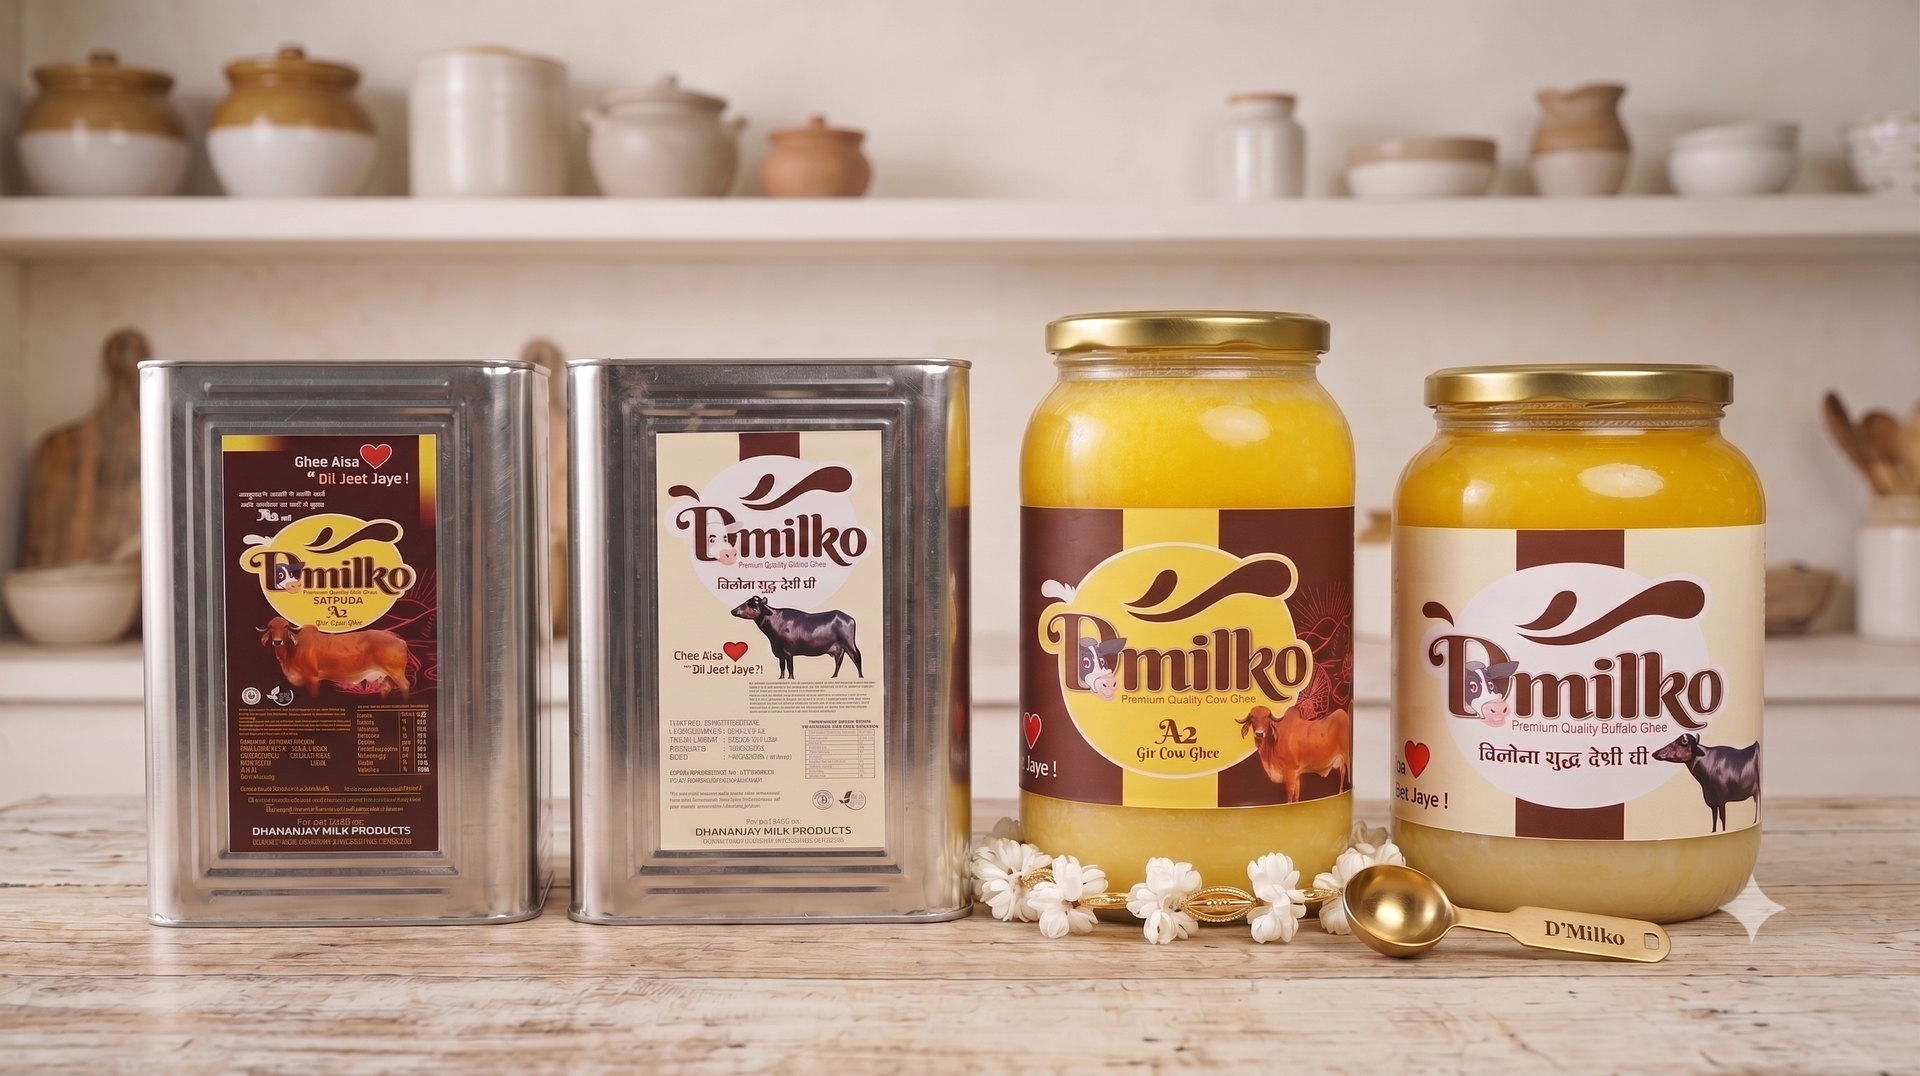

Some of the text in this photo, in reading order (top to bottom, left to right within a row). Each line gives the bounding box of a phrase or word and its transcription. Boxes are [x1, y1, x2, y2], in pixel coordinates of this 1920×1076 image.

[295, 456, 360, 467] Ghee Aisa
[319, 473, 336, 485] Dil
[339, 473, 368, 485] Jeet
[371, 473, 402, 487] Jaye
[738, 561, 764, 569] Premium
[803, 577, 817, 590] घी
[313, 596, 364, 605] SATPUDA
[674, 651, 700, 661] Chee
[706, 664, 730, 675] Jeet
[1121, 693, 1257, 707] Premium Quality Cow Ghee
[1154, 718, 1198, 745] A2
[1511, 720, 1668, 737] Premium Quality Buffalo Ghee
[1136, 747, 1157, 762] Gir
[1159, 747, 1186, 760] Cow
[1545, 751, 1582, 771] शुद्ध
[1629, 746, 1650, 765] घी
[1026, 755, 1049, 779] Jaye
[1411, 787, 1439, 810] Jaye
[252, 826, 411, 836] DHANANJAY MILK PRODUCTS
[695, 826, 852, 837] DHANANJAY MILK PRODUCTS
[1544, 919, 1625, 946] D’Milko
